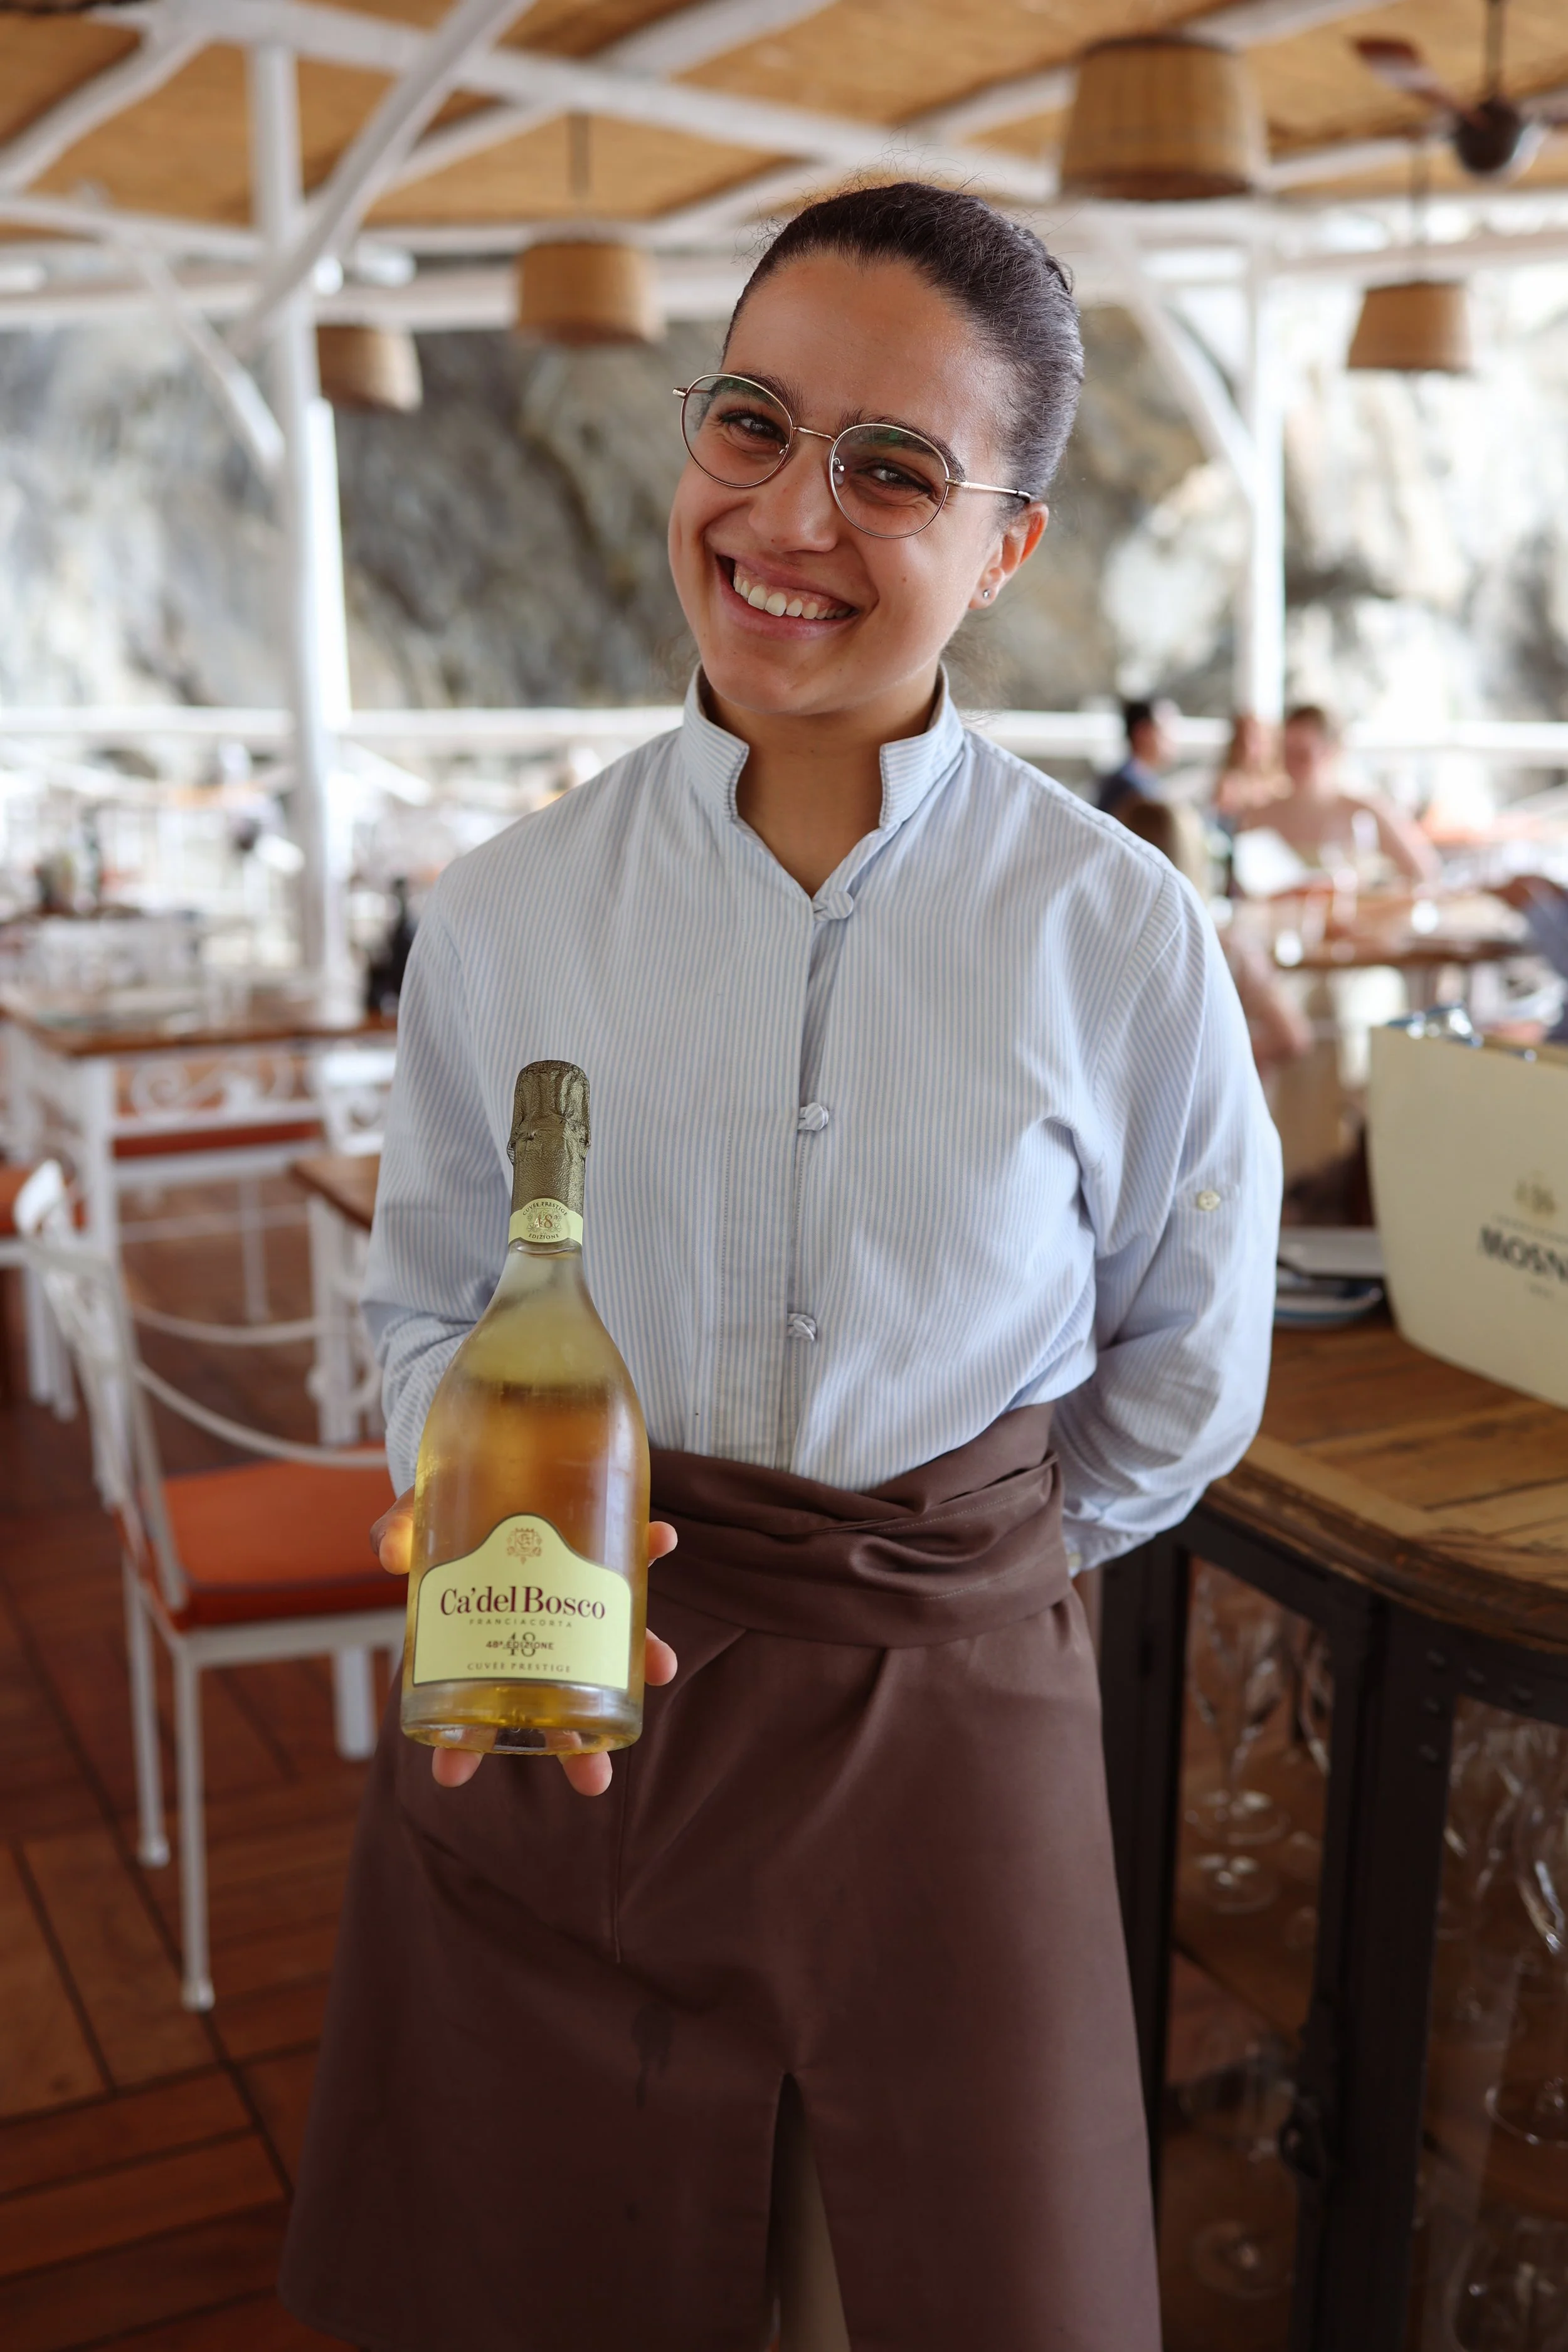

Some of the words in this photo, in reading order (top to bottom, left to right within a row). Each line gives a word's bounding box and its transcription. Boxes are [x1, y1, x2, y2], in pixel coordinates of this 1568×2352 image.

[522, 1201, 539, 1216] CUVÉE
[541, 1201, 568, 1216] PRESTIGE
[440, 1586, 516, 1616] Ca'del
[522, 1586, 606, 1619] Bosco
[469, 1618, 573, 1628] FRANCIACORTA
[467, 1662, 506, 1671] CUVÉE
[511, 1663, 571, 1673] PRESTIGE
